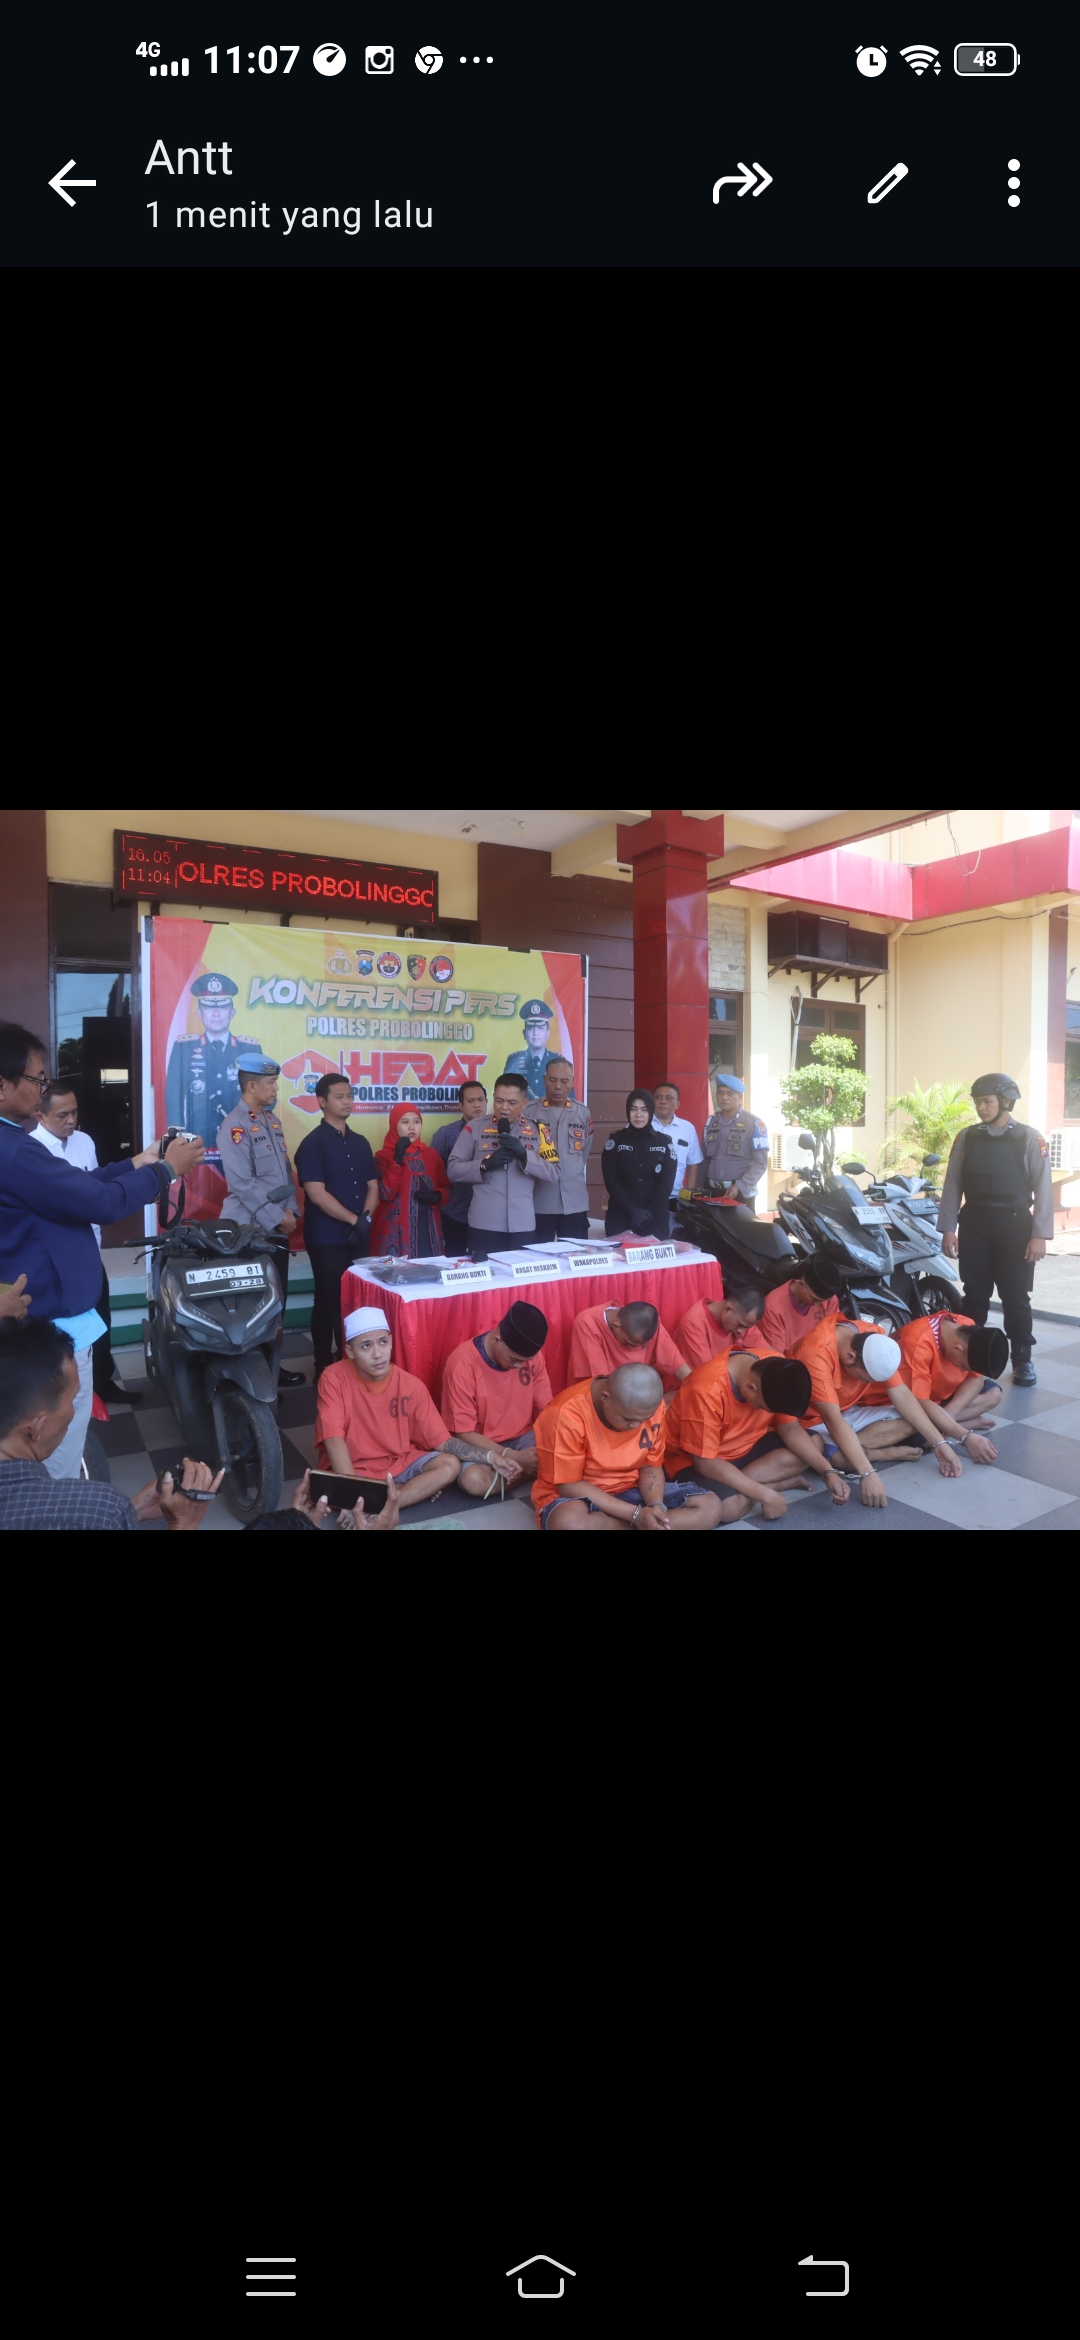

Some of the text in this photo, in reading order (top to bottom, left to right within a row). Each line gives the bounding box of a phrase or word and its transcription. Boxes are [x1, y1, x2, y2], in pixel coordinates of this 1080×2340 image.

[128, 868, 171, 884] 11:04
[178, 861, 265, 889] OLRES
[249, 976, 518, 1016] KONFERENSI PERS
[307, 1016, 474, 1041] POLRES PROBOLINGGO
[342, 1049, 488, 1086] HEBAT
[351, 1086, 399, 1102] POLRES
[629, 1246, 674, 1263] BARANG BUKTI
[188, 1273, 196, 1283] N
[206, 1268, 236, 1281] 2459
